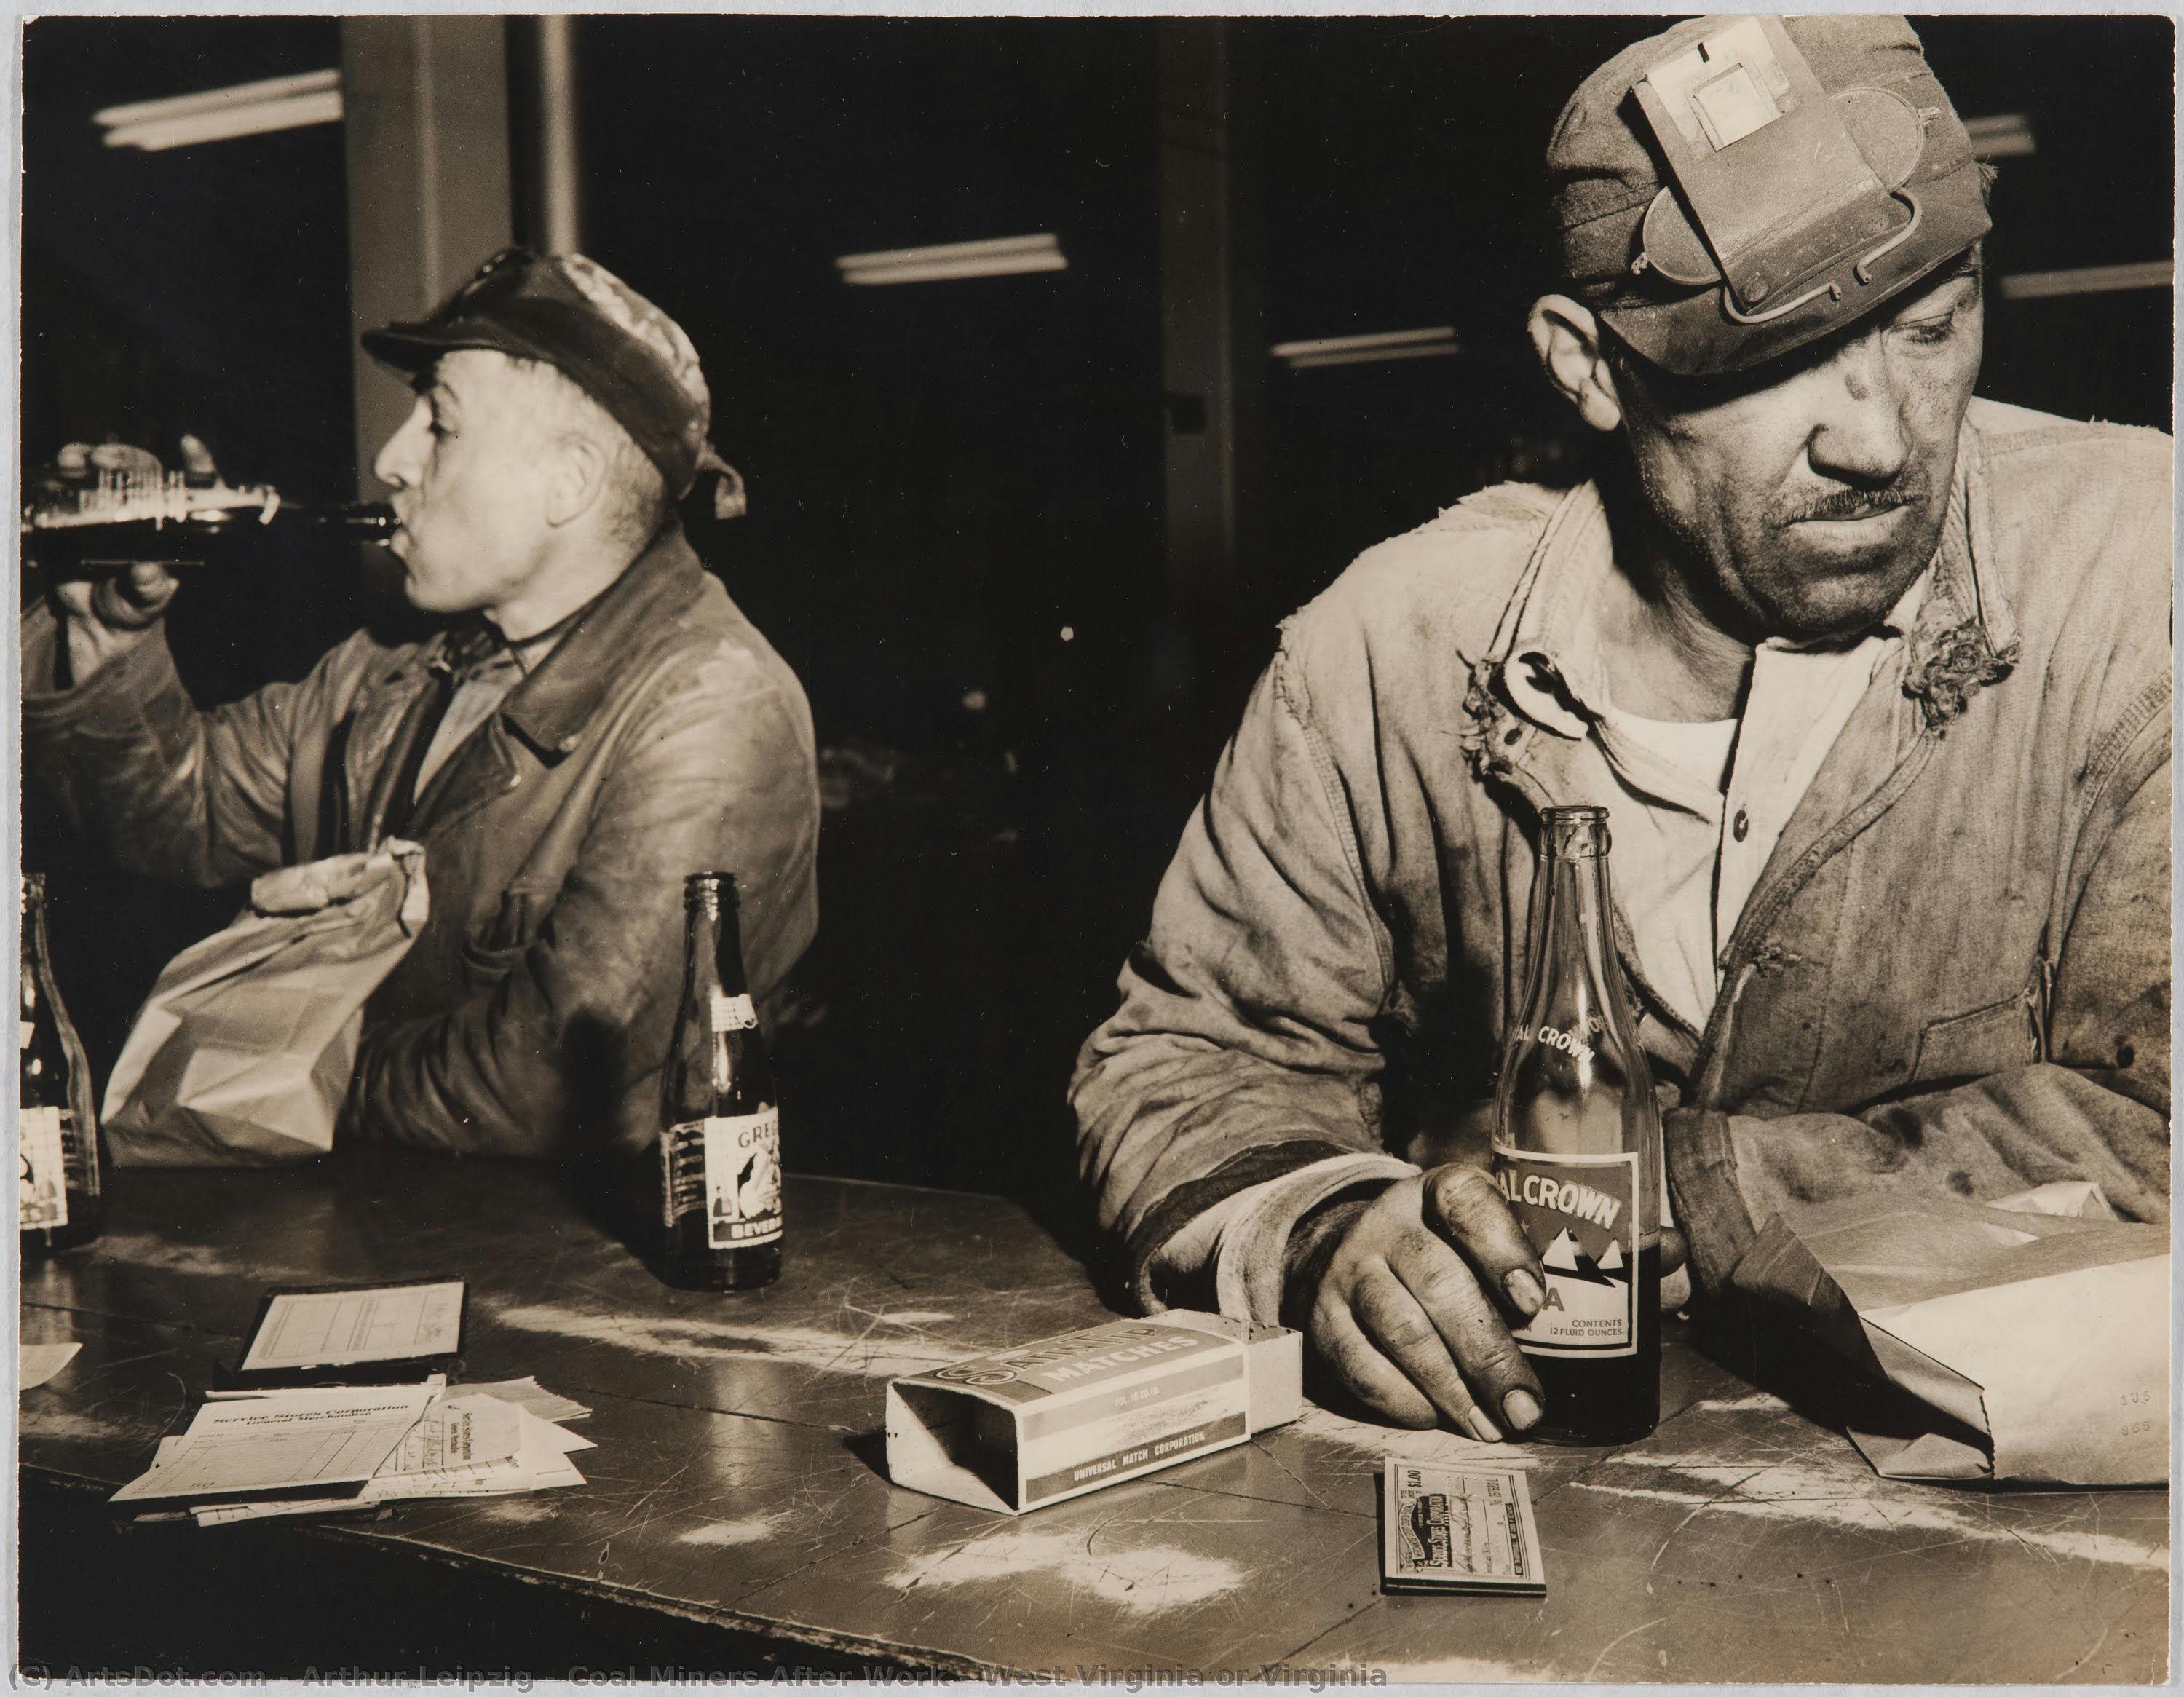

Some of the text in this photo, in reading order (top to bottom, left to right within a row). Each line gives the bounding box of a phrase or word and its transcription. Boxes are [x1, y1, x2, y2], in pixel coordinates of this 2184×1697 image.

[1538, 1026, 1596, 1062] CROWN
[1523, 1174, 1623, 1230] CROWN
[1550, 1327, 1622, 1337] 12 FLUID OUNCES
[1572, 1318, 1622, 1328] CONTENTS
[1041, 1336, 1198, 1382] MATCHES
[1074, 1431, 1206, 1482] UNIVERSAL MATCH CORPORATION
[1406, 1470, 1423, 1488] $1.00
